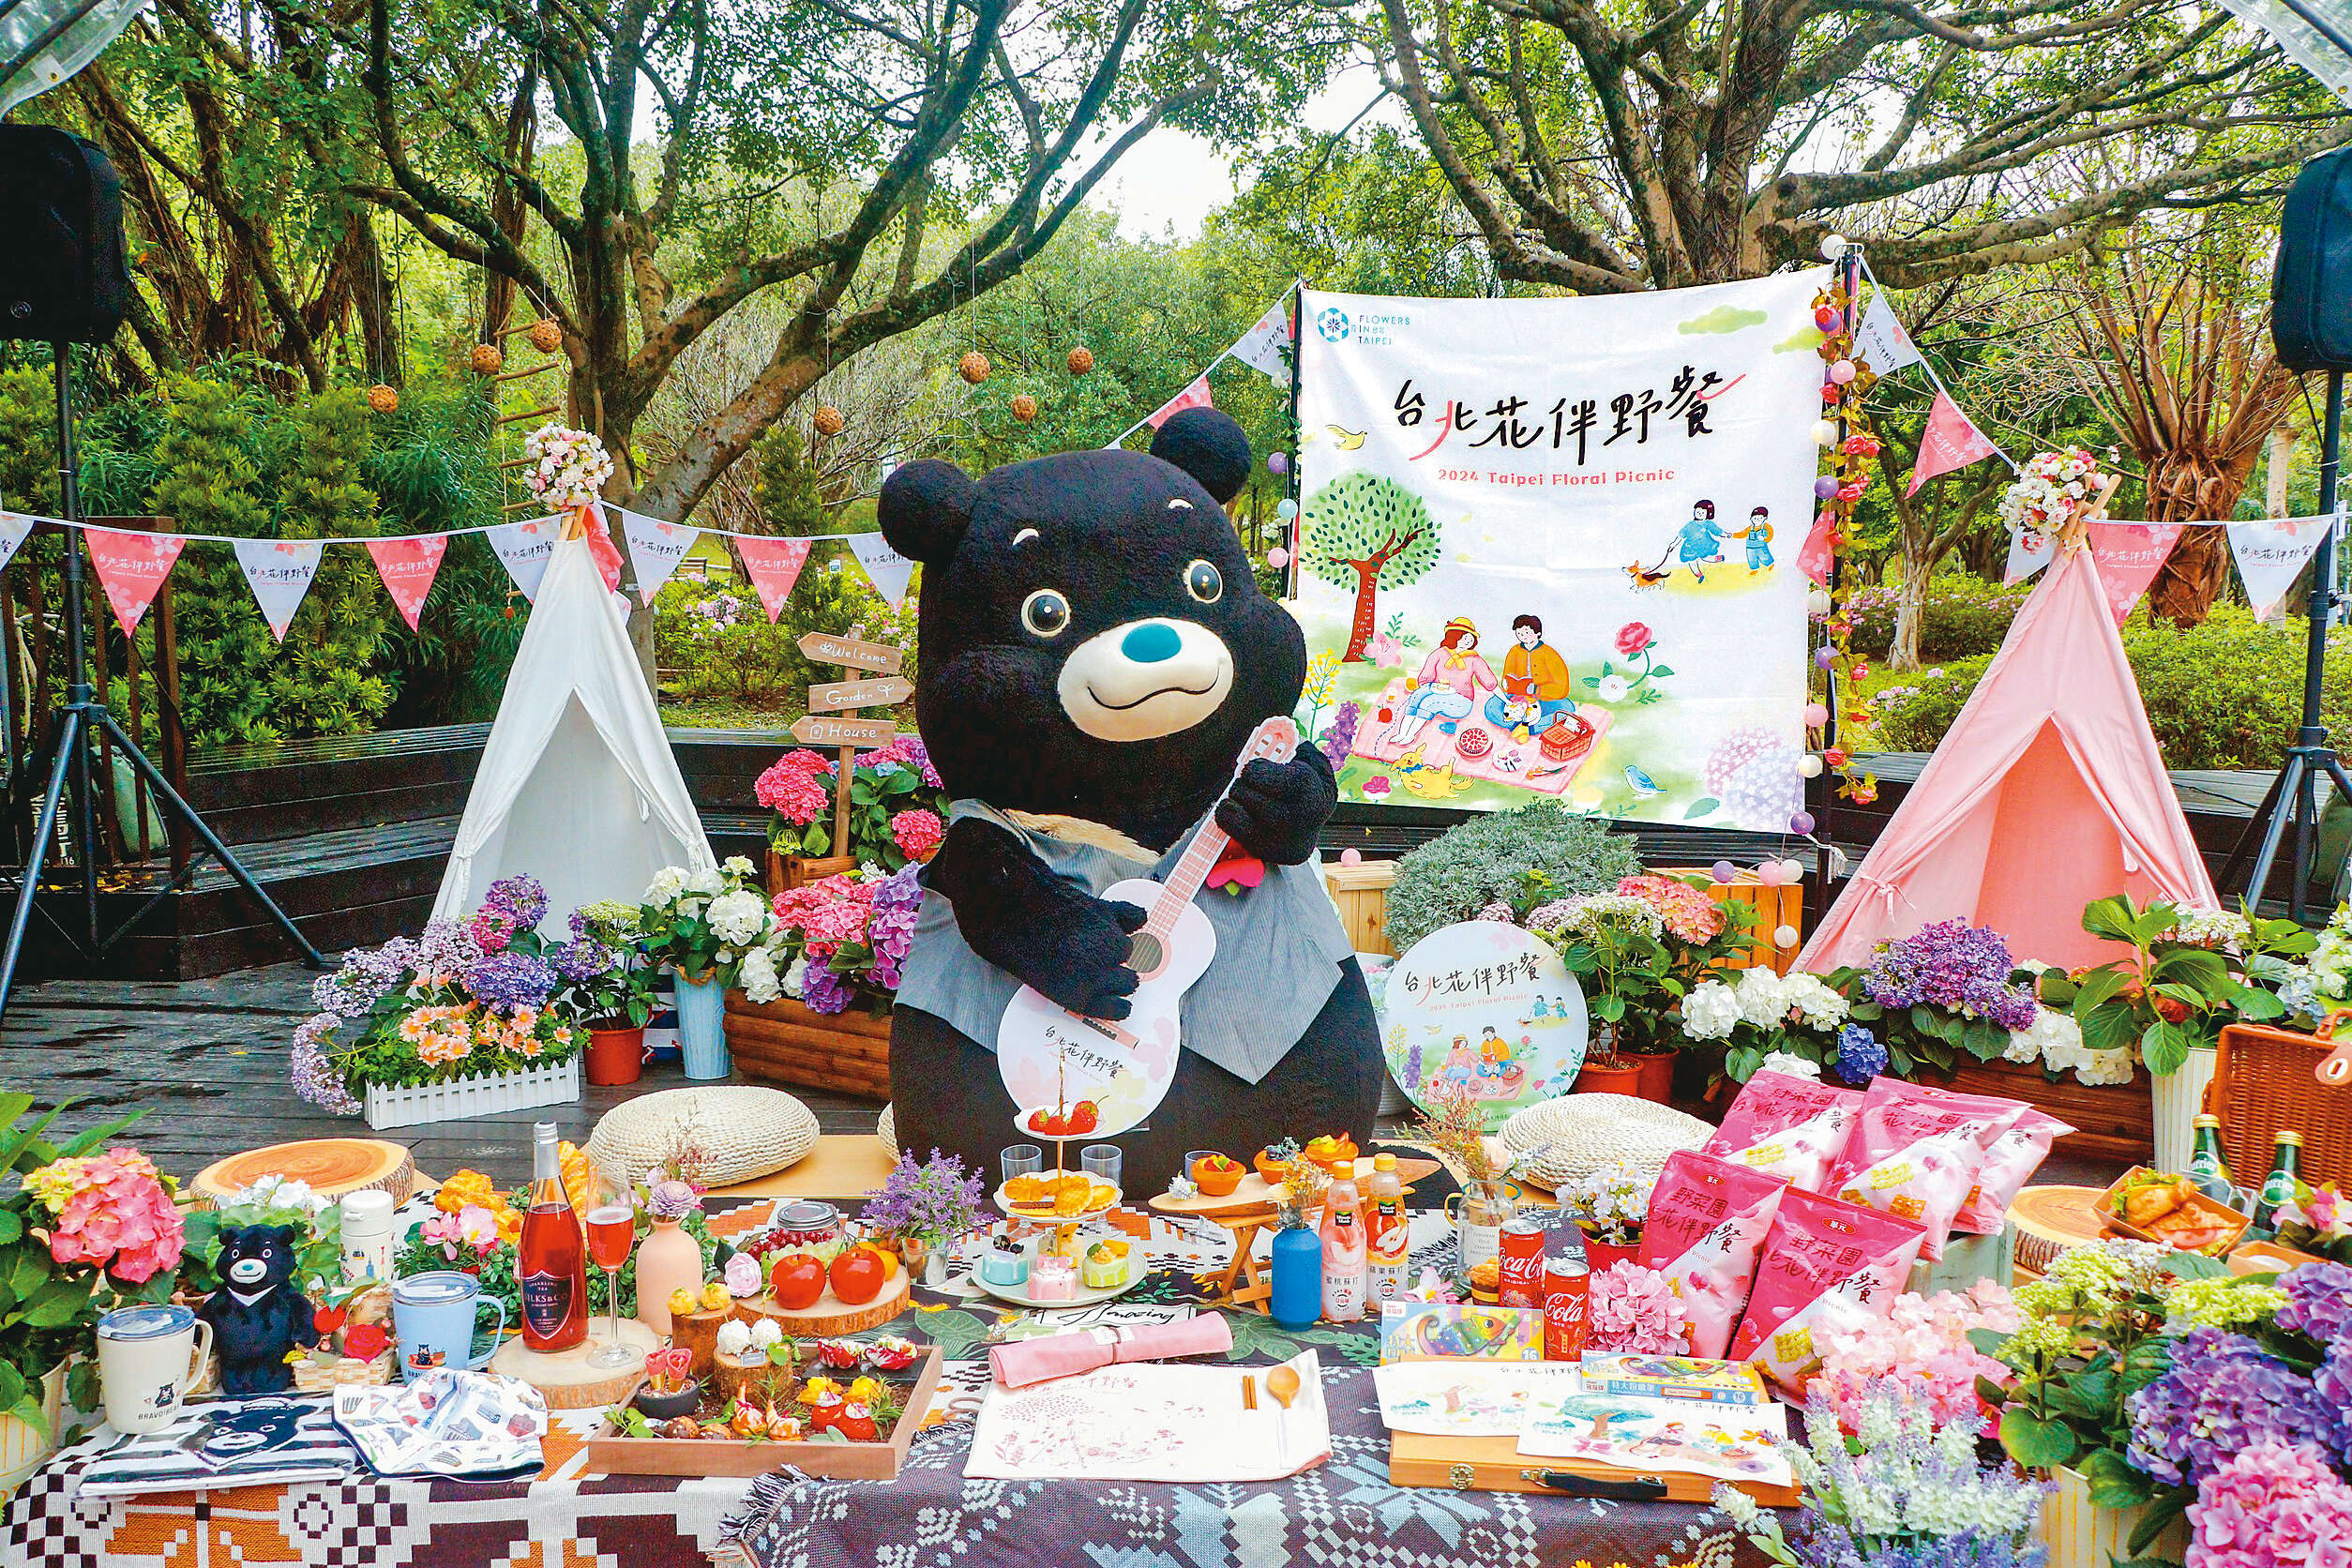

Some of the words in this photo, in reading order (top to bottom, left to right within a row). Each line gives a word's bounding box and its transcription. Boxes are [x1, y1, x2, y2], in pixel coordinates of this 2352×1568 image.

[1359, 314, 1410, 325] FLOWERS
[1358, 336, 1393, 345] TAIPEI
[1394, 365, 1746, 465] 台北花伴野餐
[1438, 469, 1480, 482] 2024
[1487, 471, 1545, 488] Taipei
[1552, 472, 1607, 486] Floral
[1615, 469, 1675, 483] Picnic
[832, 644, 887, 664] Welcome
[826, 689, 873, 705] Garden
[828, 723, 877, 738] House
[1405, 952, 1547, 1006] 台北花伴野餐
[1043, 1025, 1127, 1079] 台北花伴野餐
[1670, 1186, 1728, 1219] 野菜園
[1829, 1220, 1847, 1232] 華元
[1789, 1229, 1863, 1267] 野菜園
[1545, 1292, 1588, 1323] Cola
